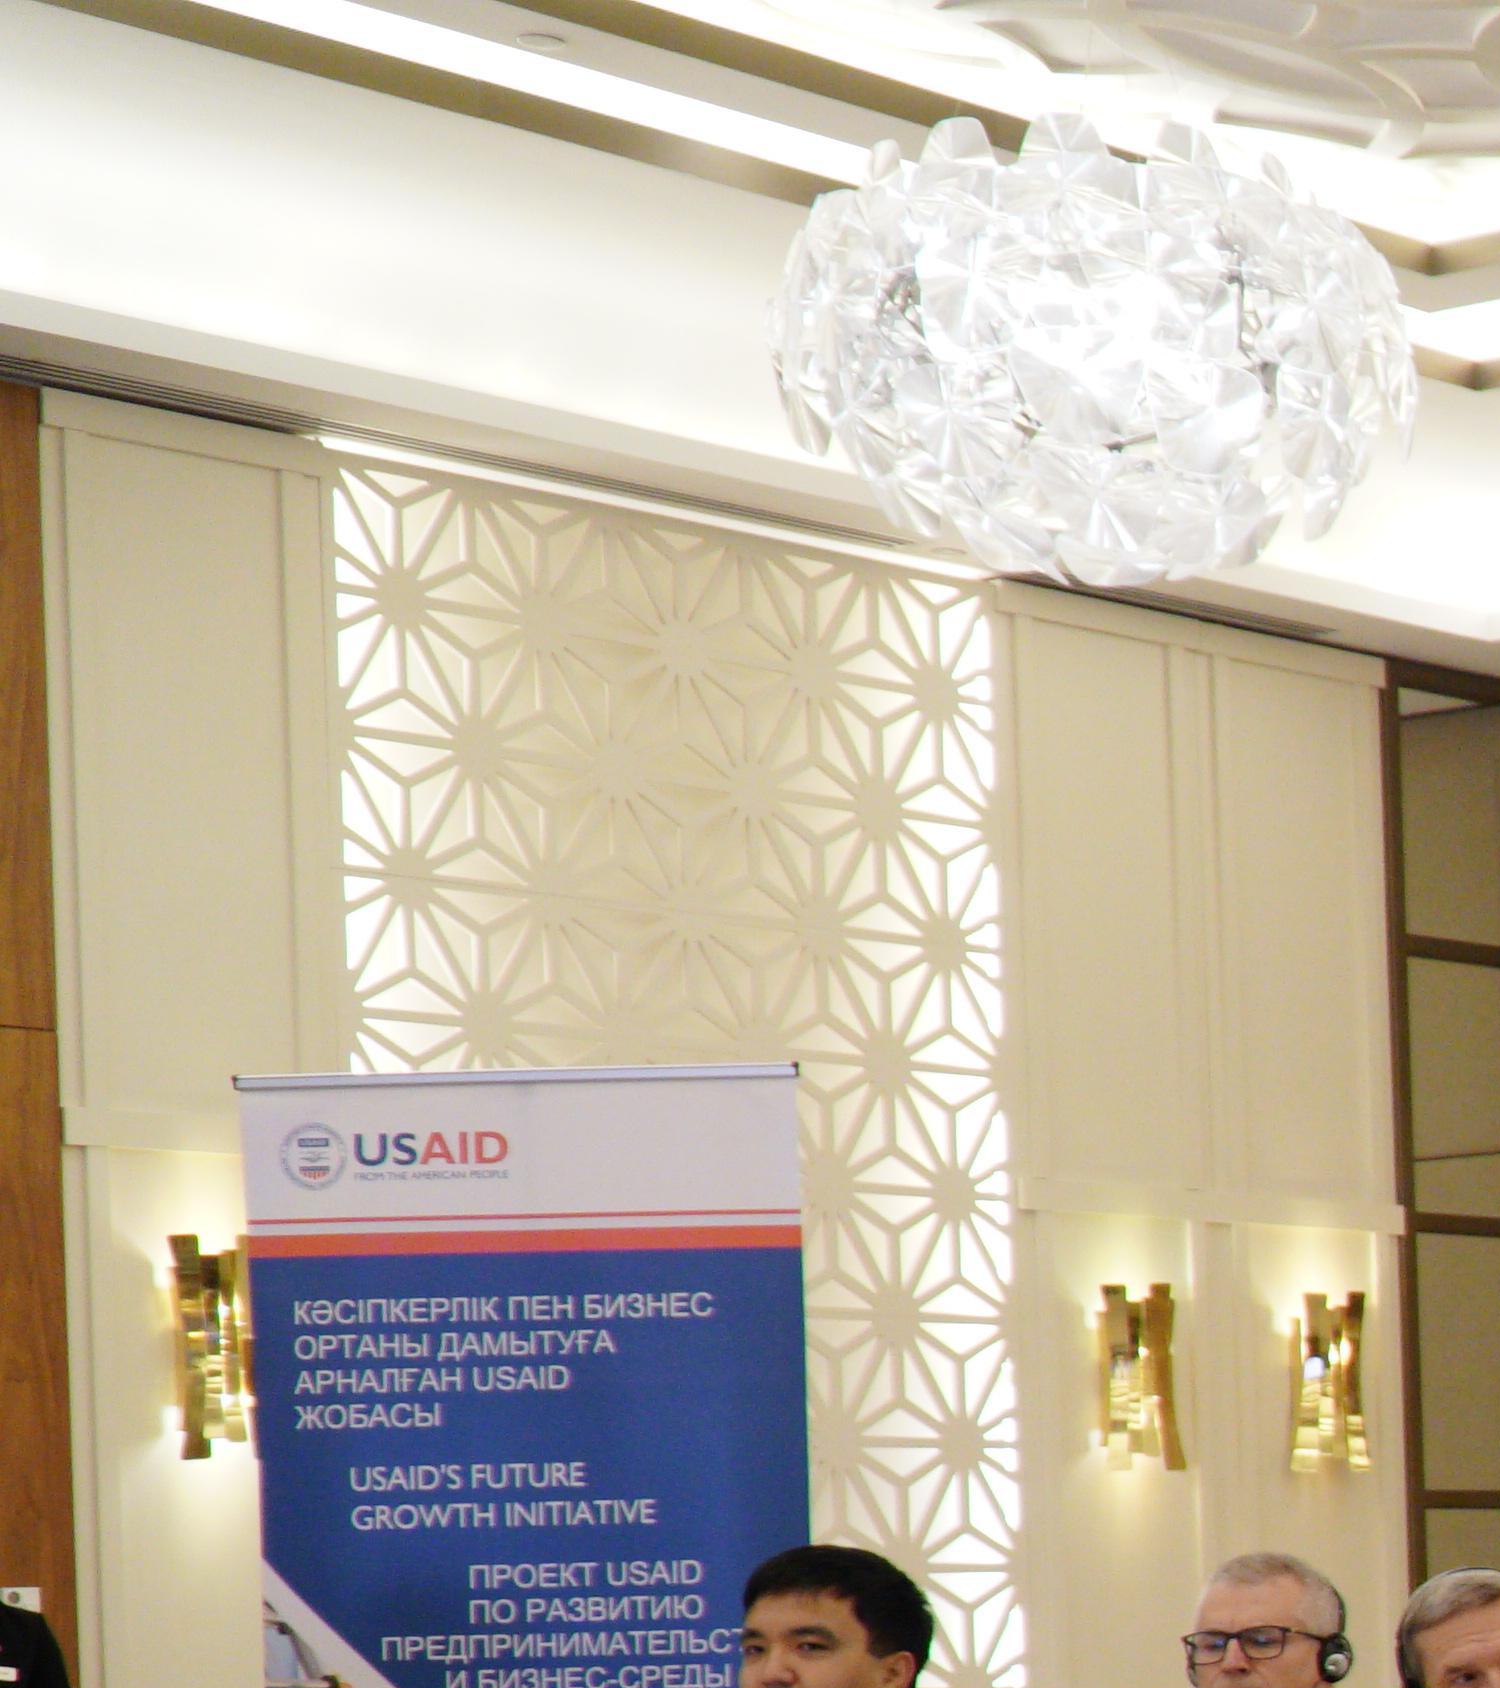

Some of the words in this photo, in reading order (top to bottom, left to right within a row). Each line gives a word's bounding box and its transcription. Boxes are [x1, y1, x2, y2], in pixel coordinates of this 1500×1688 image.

[353, 1130, 509, 1166] USAID
[354, 1171, 385, 1181] FROM
[387, 1171, 408, 1181] THE
[411, 1169, 467, 1180] AMERICAN
[470, 1168, 509, 1179] PEOPLE
[293, 1297, 499, 1325] КӘСІПКЕРЛІК
[508, 1295, 575, 1320] ПЕН
[583, 1292, 714, 1319] БИЗНЕС
[294, 1333, 429, 1360] ОРТАНЫ
[437, 1329, 617, 1361] ДАМЫТУҒА
[294, 1367, 463, 1394] АРНАЛҒАН
[473, 1365, 571, 1391] USAID
[295, 1402, 442, 1429] ЖОБАСЫ
[350, 1464, 462, 1492] USAID'S
[471, 1462, 587, 1489] FUTURE
[351, 1502, 496, 1531] GROWTH
[505, 1499, 658, 1527] INITIATIVE
[468, 1562, 600, 1590] ПРОЕКТ
[606, 1560, 703, 1587] USAID
[468, 1599, 517, 1625] ПО
[525, 1594, 705, 1623] РАЗВИТИЮ
